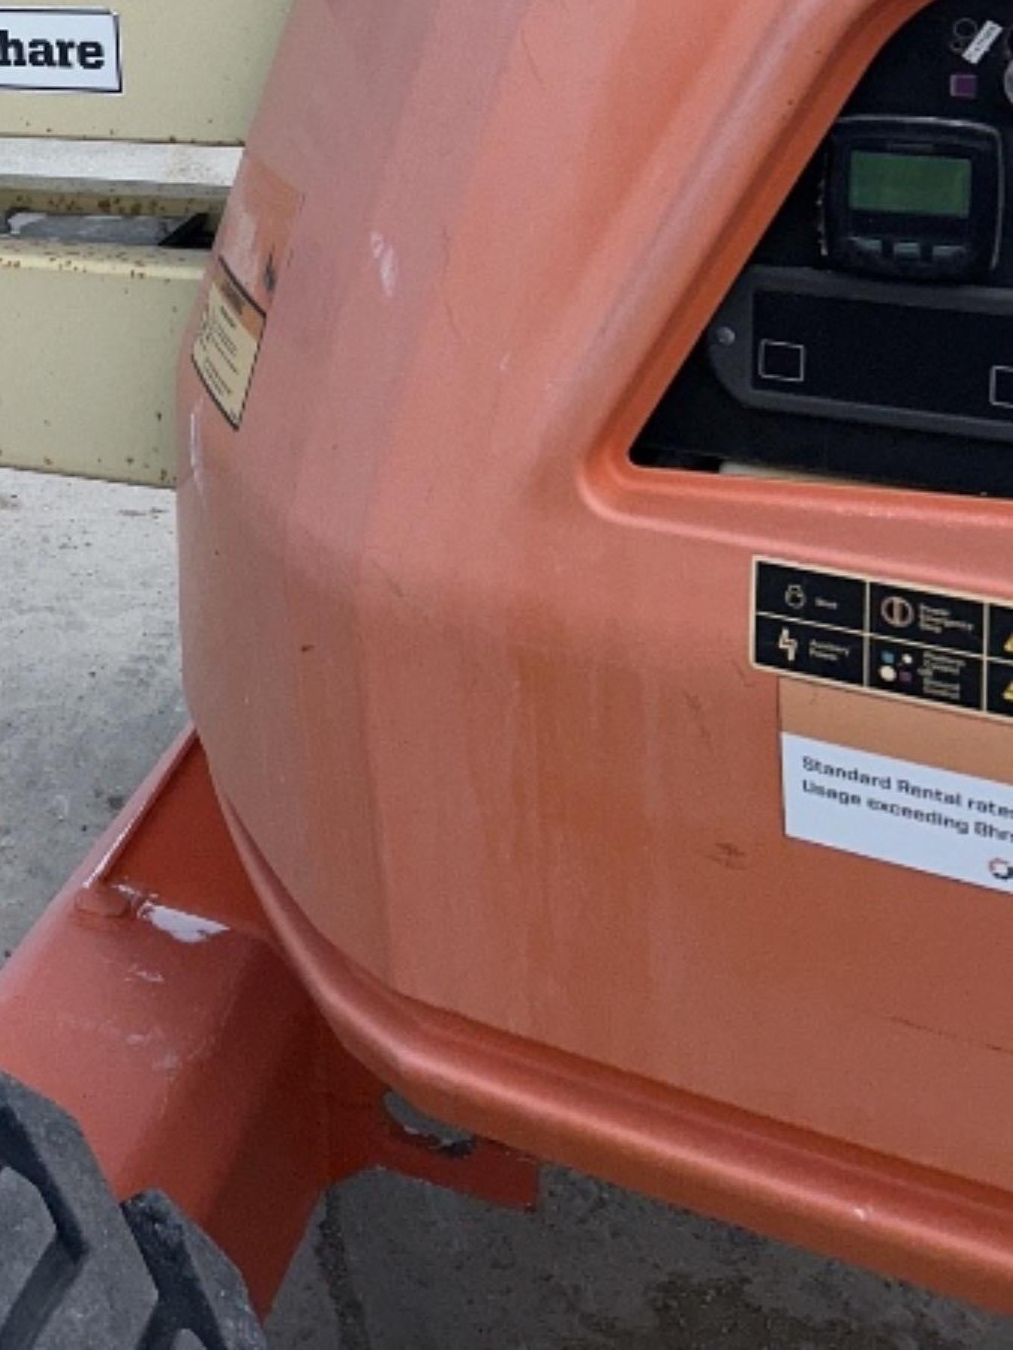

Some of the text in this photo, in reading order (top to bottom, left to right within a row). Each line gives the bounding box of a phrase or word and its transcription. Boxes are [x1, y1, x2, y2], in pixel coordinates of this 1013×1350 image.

[802, 756, 892, 791] Standard
[896, 779, 963, 808] Rental
[802, 779, 861, 805] Usage
[866, 798, 970, 835] exceeding
